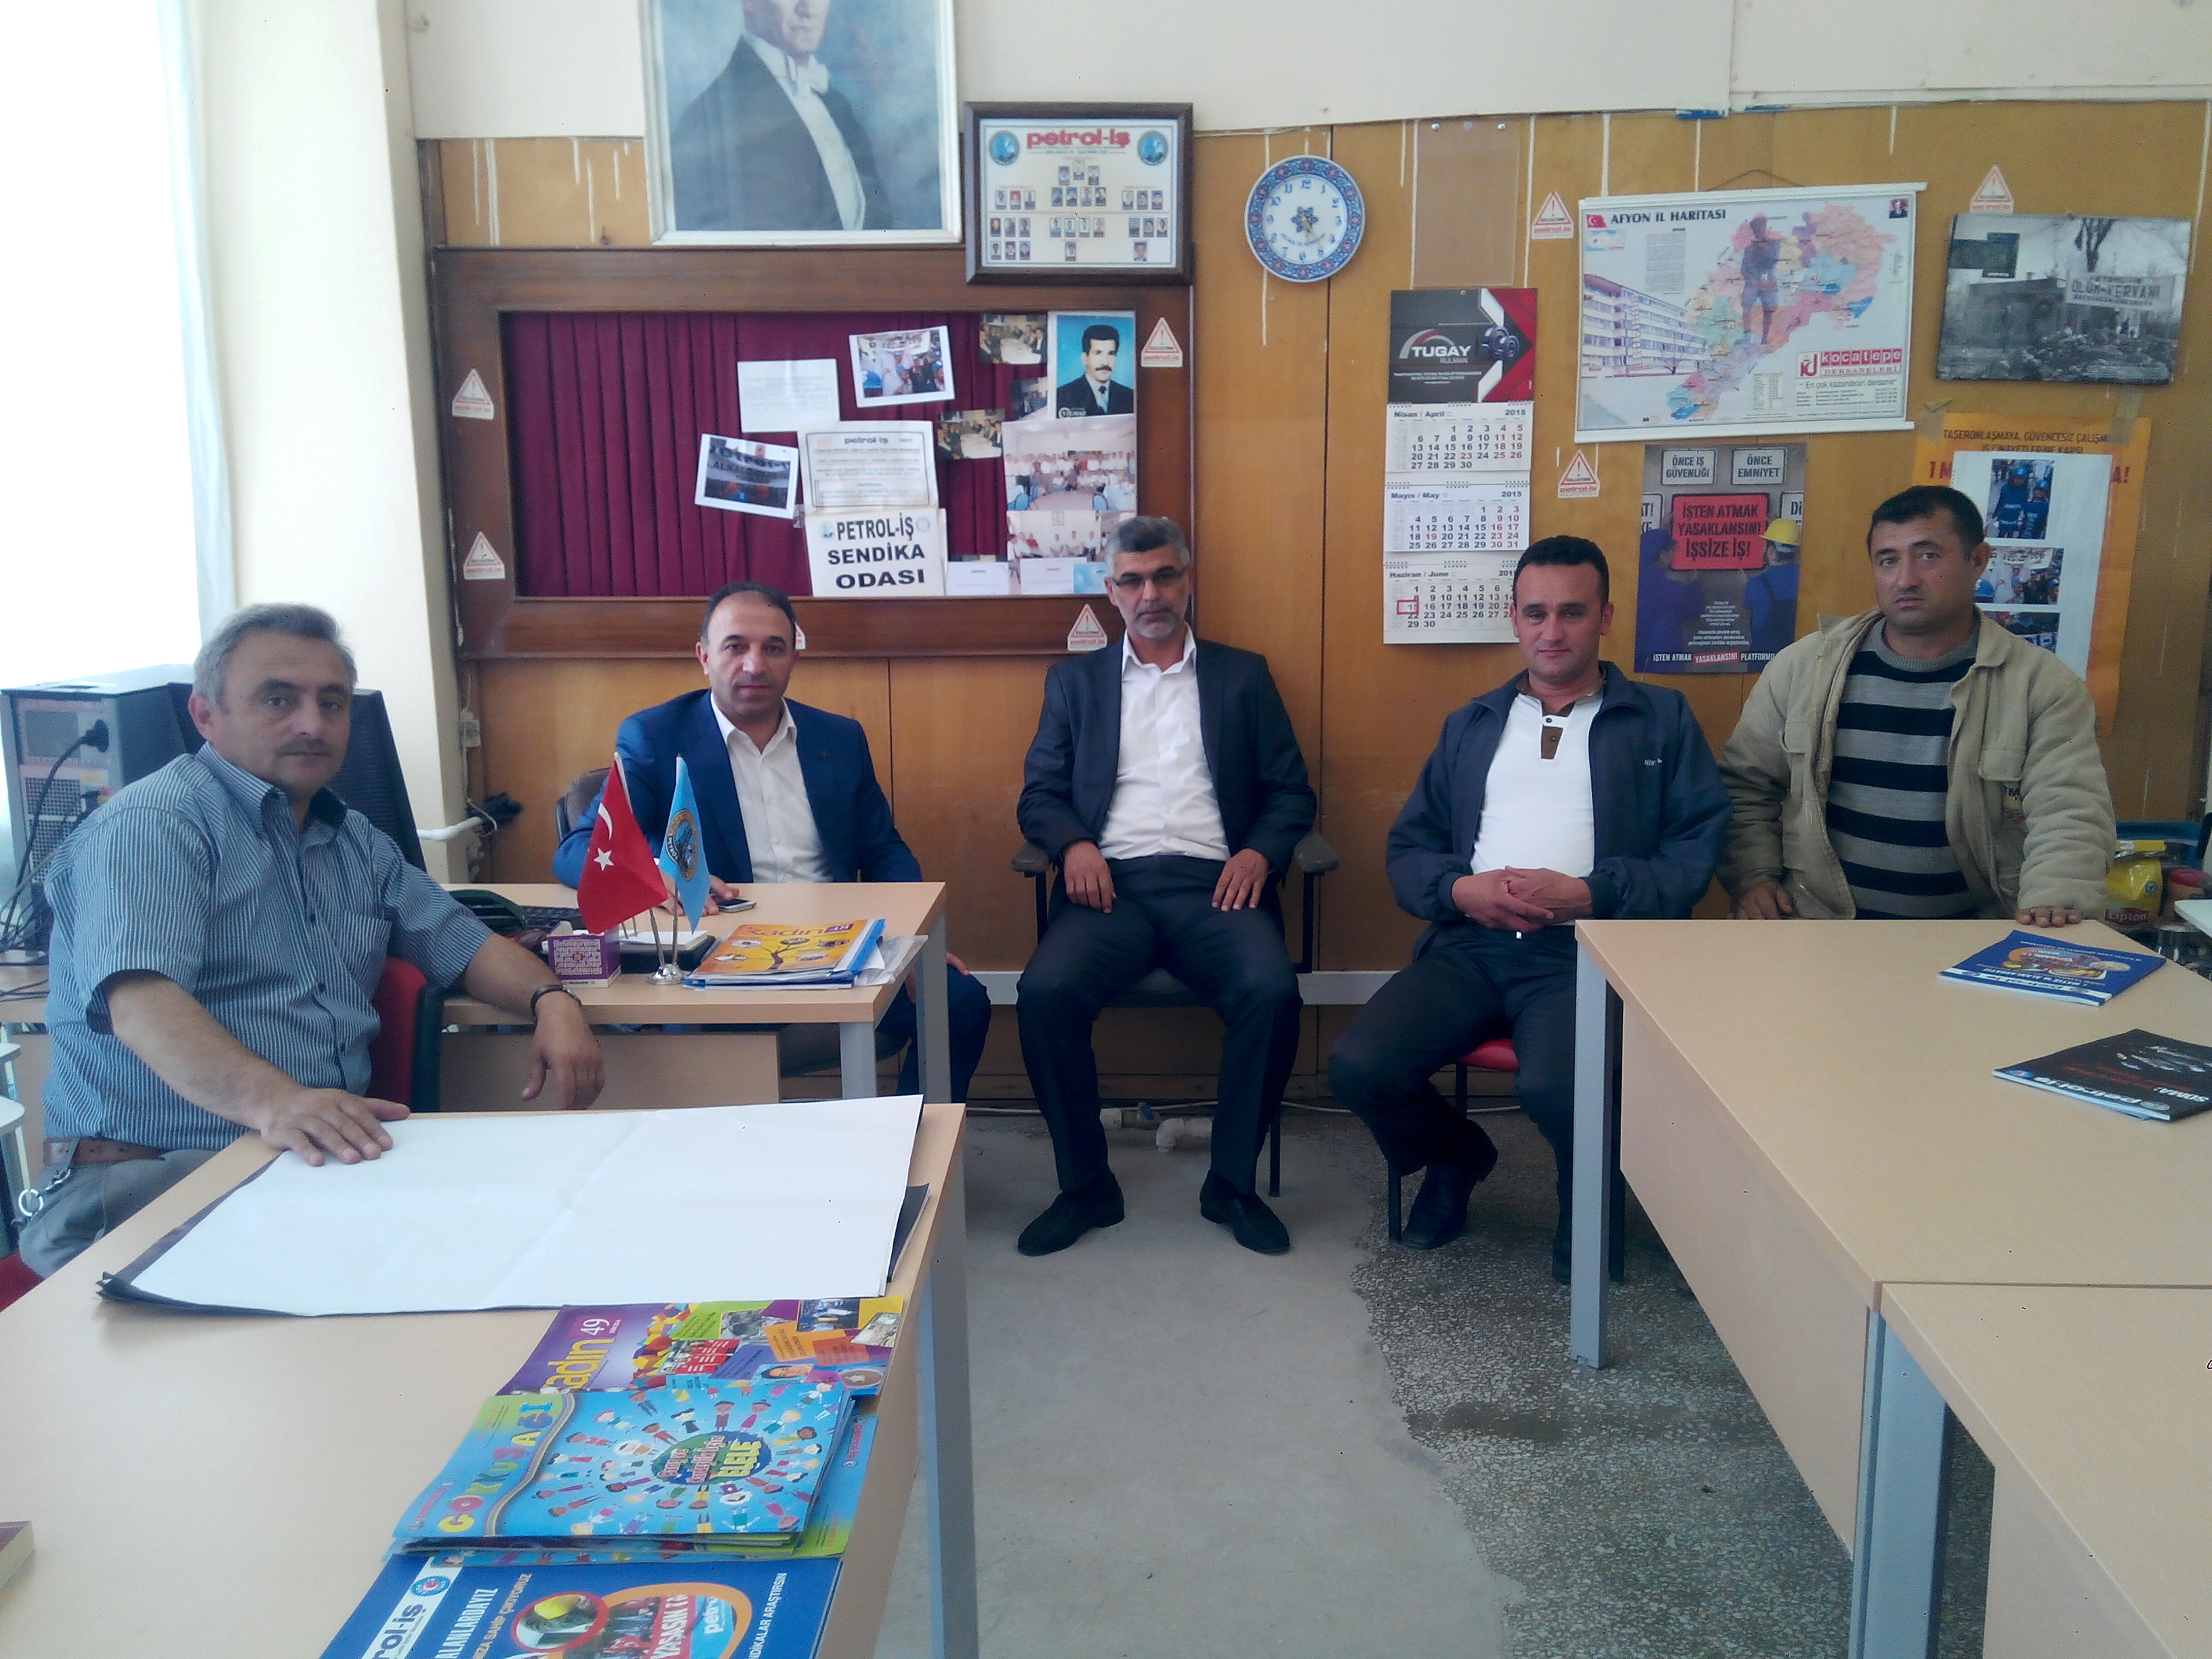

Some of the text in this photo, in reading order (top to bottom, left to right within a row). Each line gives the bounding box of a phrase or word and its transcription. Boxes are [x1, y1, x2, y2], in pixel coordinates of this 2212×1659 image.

[1610, 211, 1651, 224] AFYON
[1411, 345, 1472, 358] TUGAY
[1821, 350, 1902, 364] kocatepe
[1484, 424, 1490, 432] 3
[1517, 424, 1523, 432] 5
[1417, 434, 1424, 443] 6
[1467, 434, 1473, 442] 9
[1511, 433, 1523, 441] 12
[1444, 443, 1456, 451] 15
[1511, 442, 1523, 450] 19
[1411, 453, 1423, 461] 20
[1444, 452, 1456, 460] 22
[1460, 452, 1473, 460] 23
[1477, 451, 1489, 459] 24
[1493, 451, 1506, 459] 25
[1672, 454, 1696, 466] ÖNCE
[1746, 453, 1773, 466] ÖNCE
[1410, 462, 1423, 470] 27
[1443, 461, 1456, 469] 29
[1460, 461, 1473, 469] 30
[1423, 492, 1440, 500] May
[1717, 504, 1759, 518] ATMAK
[1431, 515, 1437, 523] 5
[1496, 514, 1503, 523] 9
[836, 513, 914, 541] PETROL-İŞ
[1426, 524, 1437, 532] 12
[1475, 523, 1487, 531] 15
[1474, 532, 1486, 540] 22
[1409, 541, 1421, 550] 25
[827, 541, 926, 565] SENDİKA
[836, 568, 925, 590] ODASI
[1430, 585, 1436, 593] 2
[1479, 584, 1485, 592] 5
[1429, 594, 1436, 602] 9
[1489, 593, 1500, 601] 13
[1424, 602, 1436, 611] 16
[1473, 602, 1484, 610] 19
[1488, 602, 1500, 610] 20
[1456, 611, 1469, 619] 25
[1407, 620, 1420, 628] 29
[1672, 653, 1692, 661] ATMAK
[2108, 912, 2148, 922] Lipton
[543, 1317, 615, 1389] adın 49
[717, 1439, 762, 1477] ELELE
